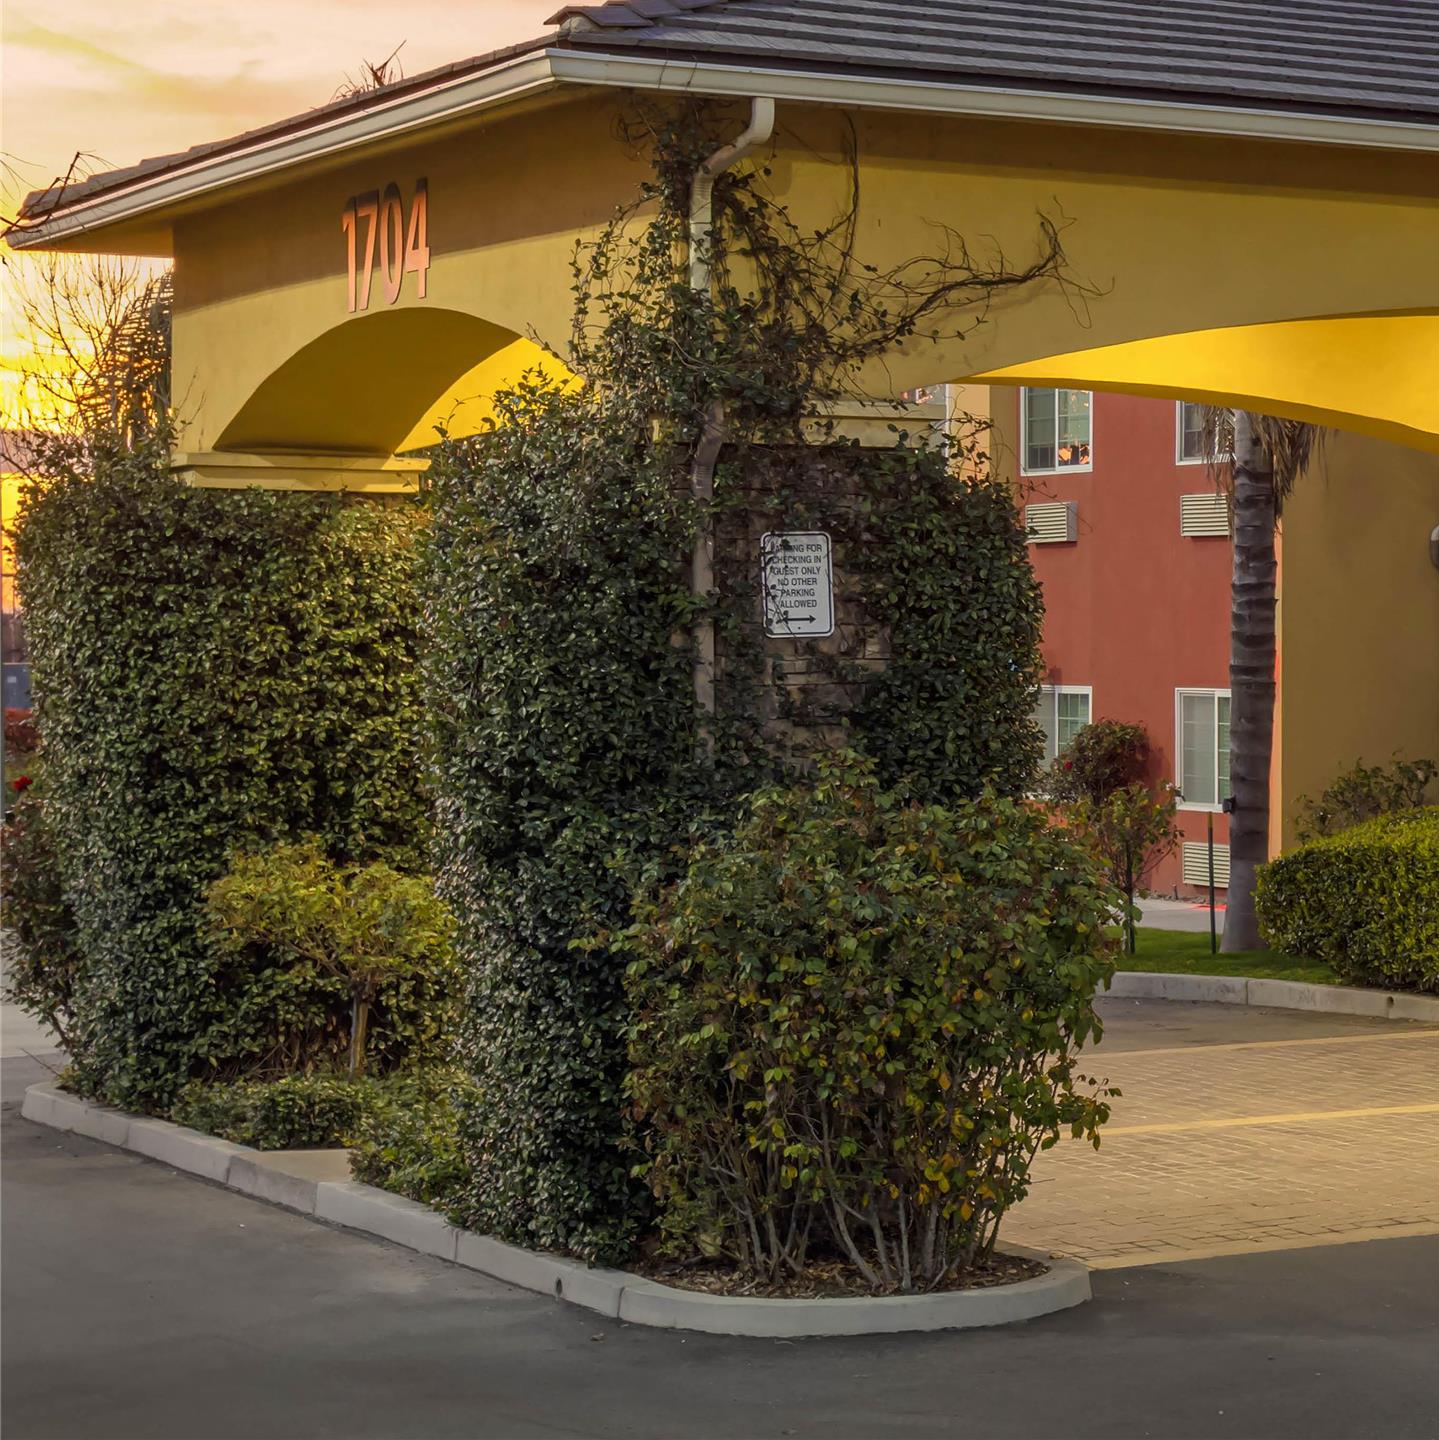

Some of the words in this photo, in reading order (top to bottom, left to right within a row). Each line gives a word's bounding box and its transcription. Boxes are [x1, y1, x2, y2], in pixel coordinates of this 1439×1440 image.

[341, 176, 431, 313] 1704
[806, 544, 823, 553] FOR
[772, 555, 812, 564] CHECKING
[813, 555, 822, 564] IN
[773, 566, 799, 575] GUEST
[801, 566, 821, 575] ONLY
[777, 577, 789, 586] NO
[791, 577, 818, 586] OTHER
[780, 588, 815, 597] PARKING
[780, 599, 818, 608] ALLOWED
